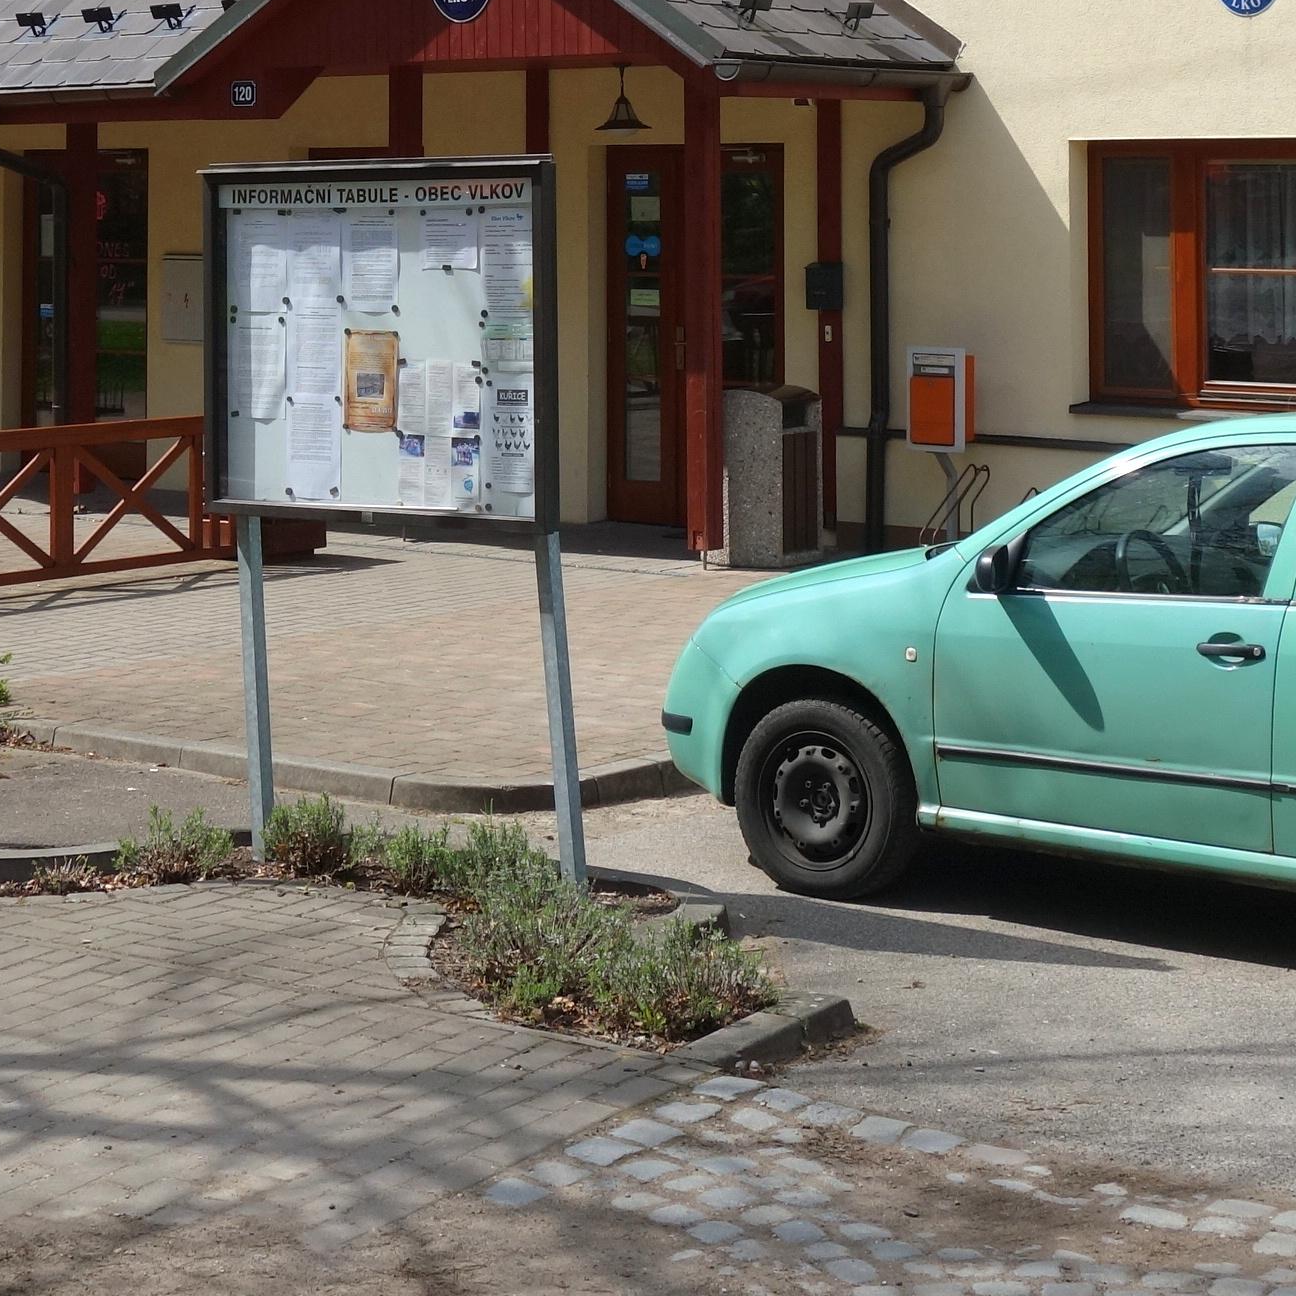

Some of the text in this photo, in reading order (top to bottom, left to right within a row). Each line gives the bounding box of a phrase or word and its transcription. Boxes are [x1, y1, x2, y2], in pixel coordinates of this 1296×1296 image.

[233, 86, 252, 102] 120
[231, 184, 332, 204] INFORMAČNÍ
[336, 188, 399, 204] TABULE
[415, 185, 462, 202] OBEC
[468, 183, 525, 200] VLKOV
